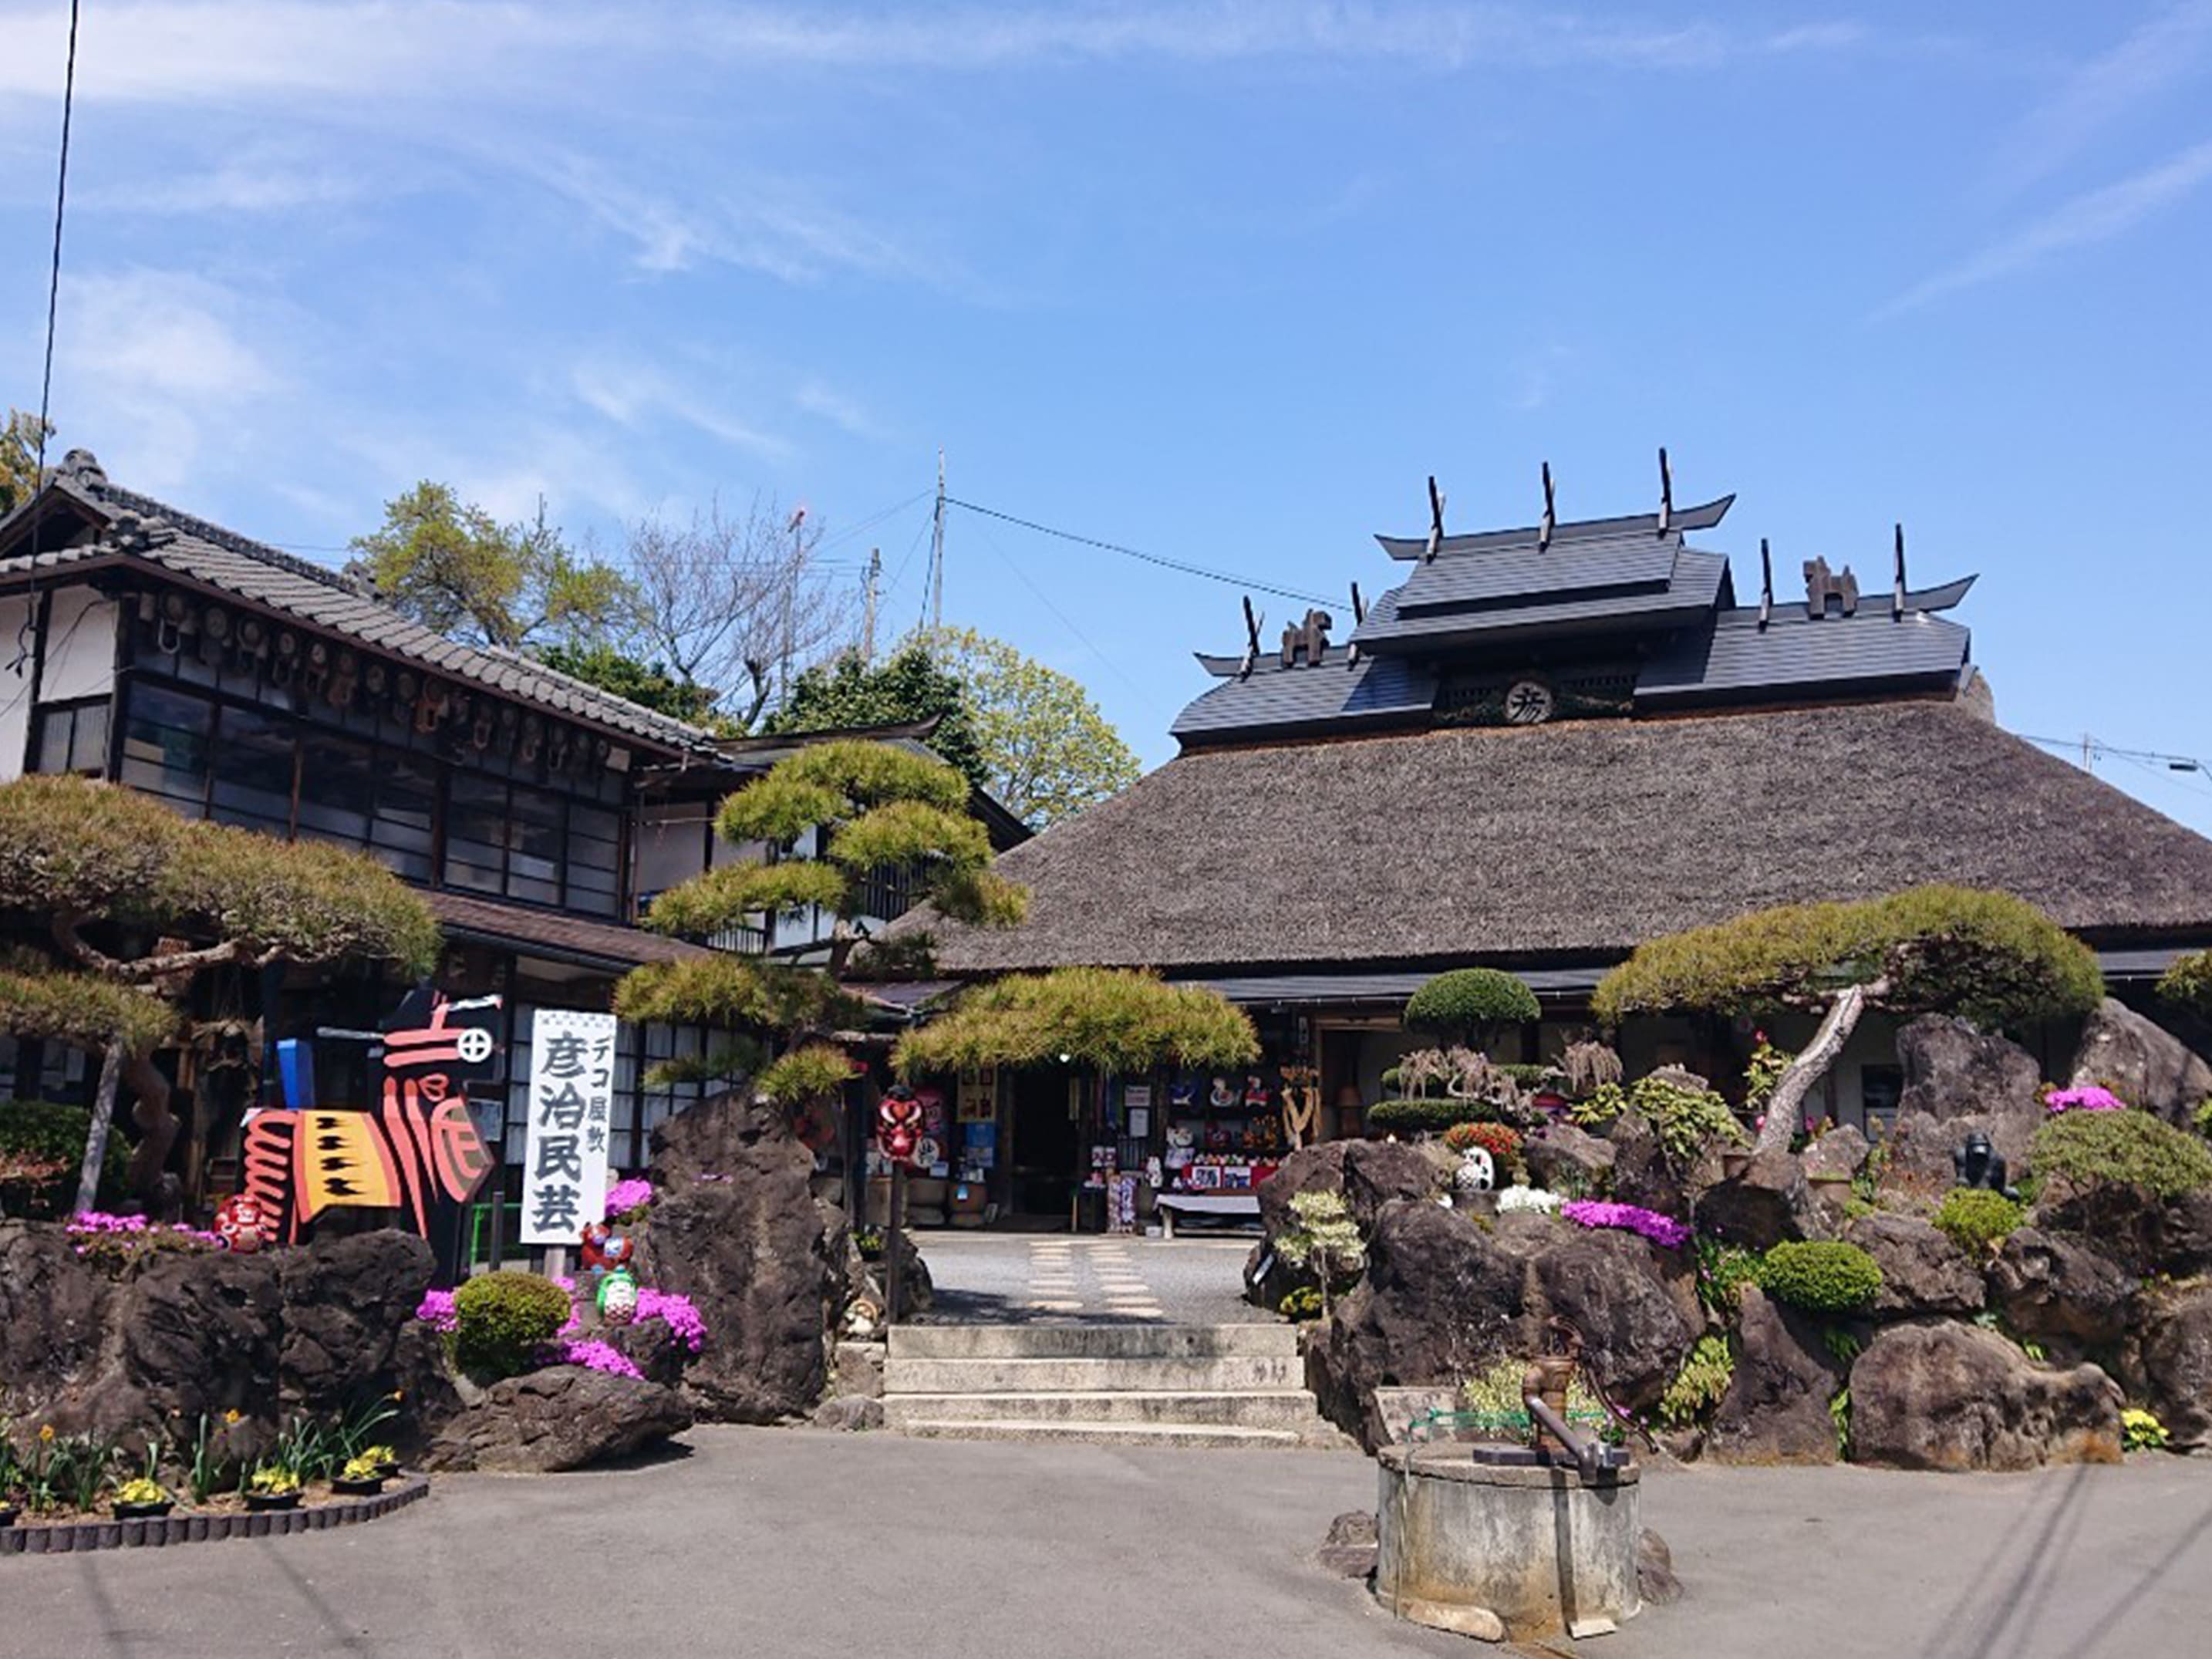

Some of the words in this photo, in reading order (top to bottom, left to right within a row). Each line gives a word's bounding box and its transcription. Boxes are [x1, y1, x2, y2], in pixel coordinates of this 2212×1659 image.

[531, 1030, 588, 1233] 彦治民芸
[587, 1034, 612, 1153] デコ屋敷
